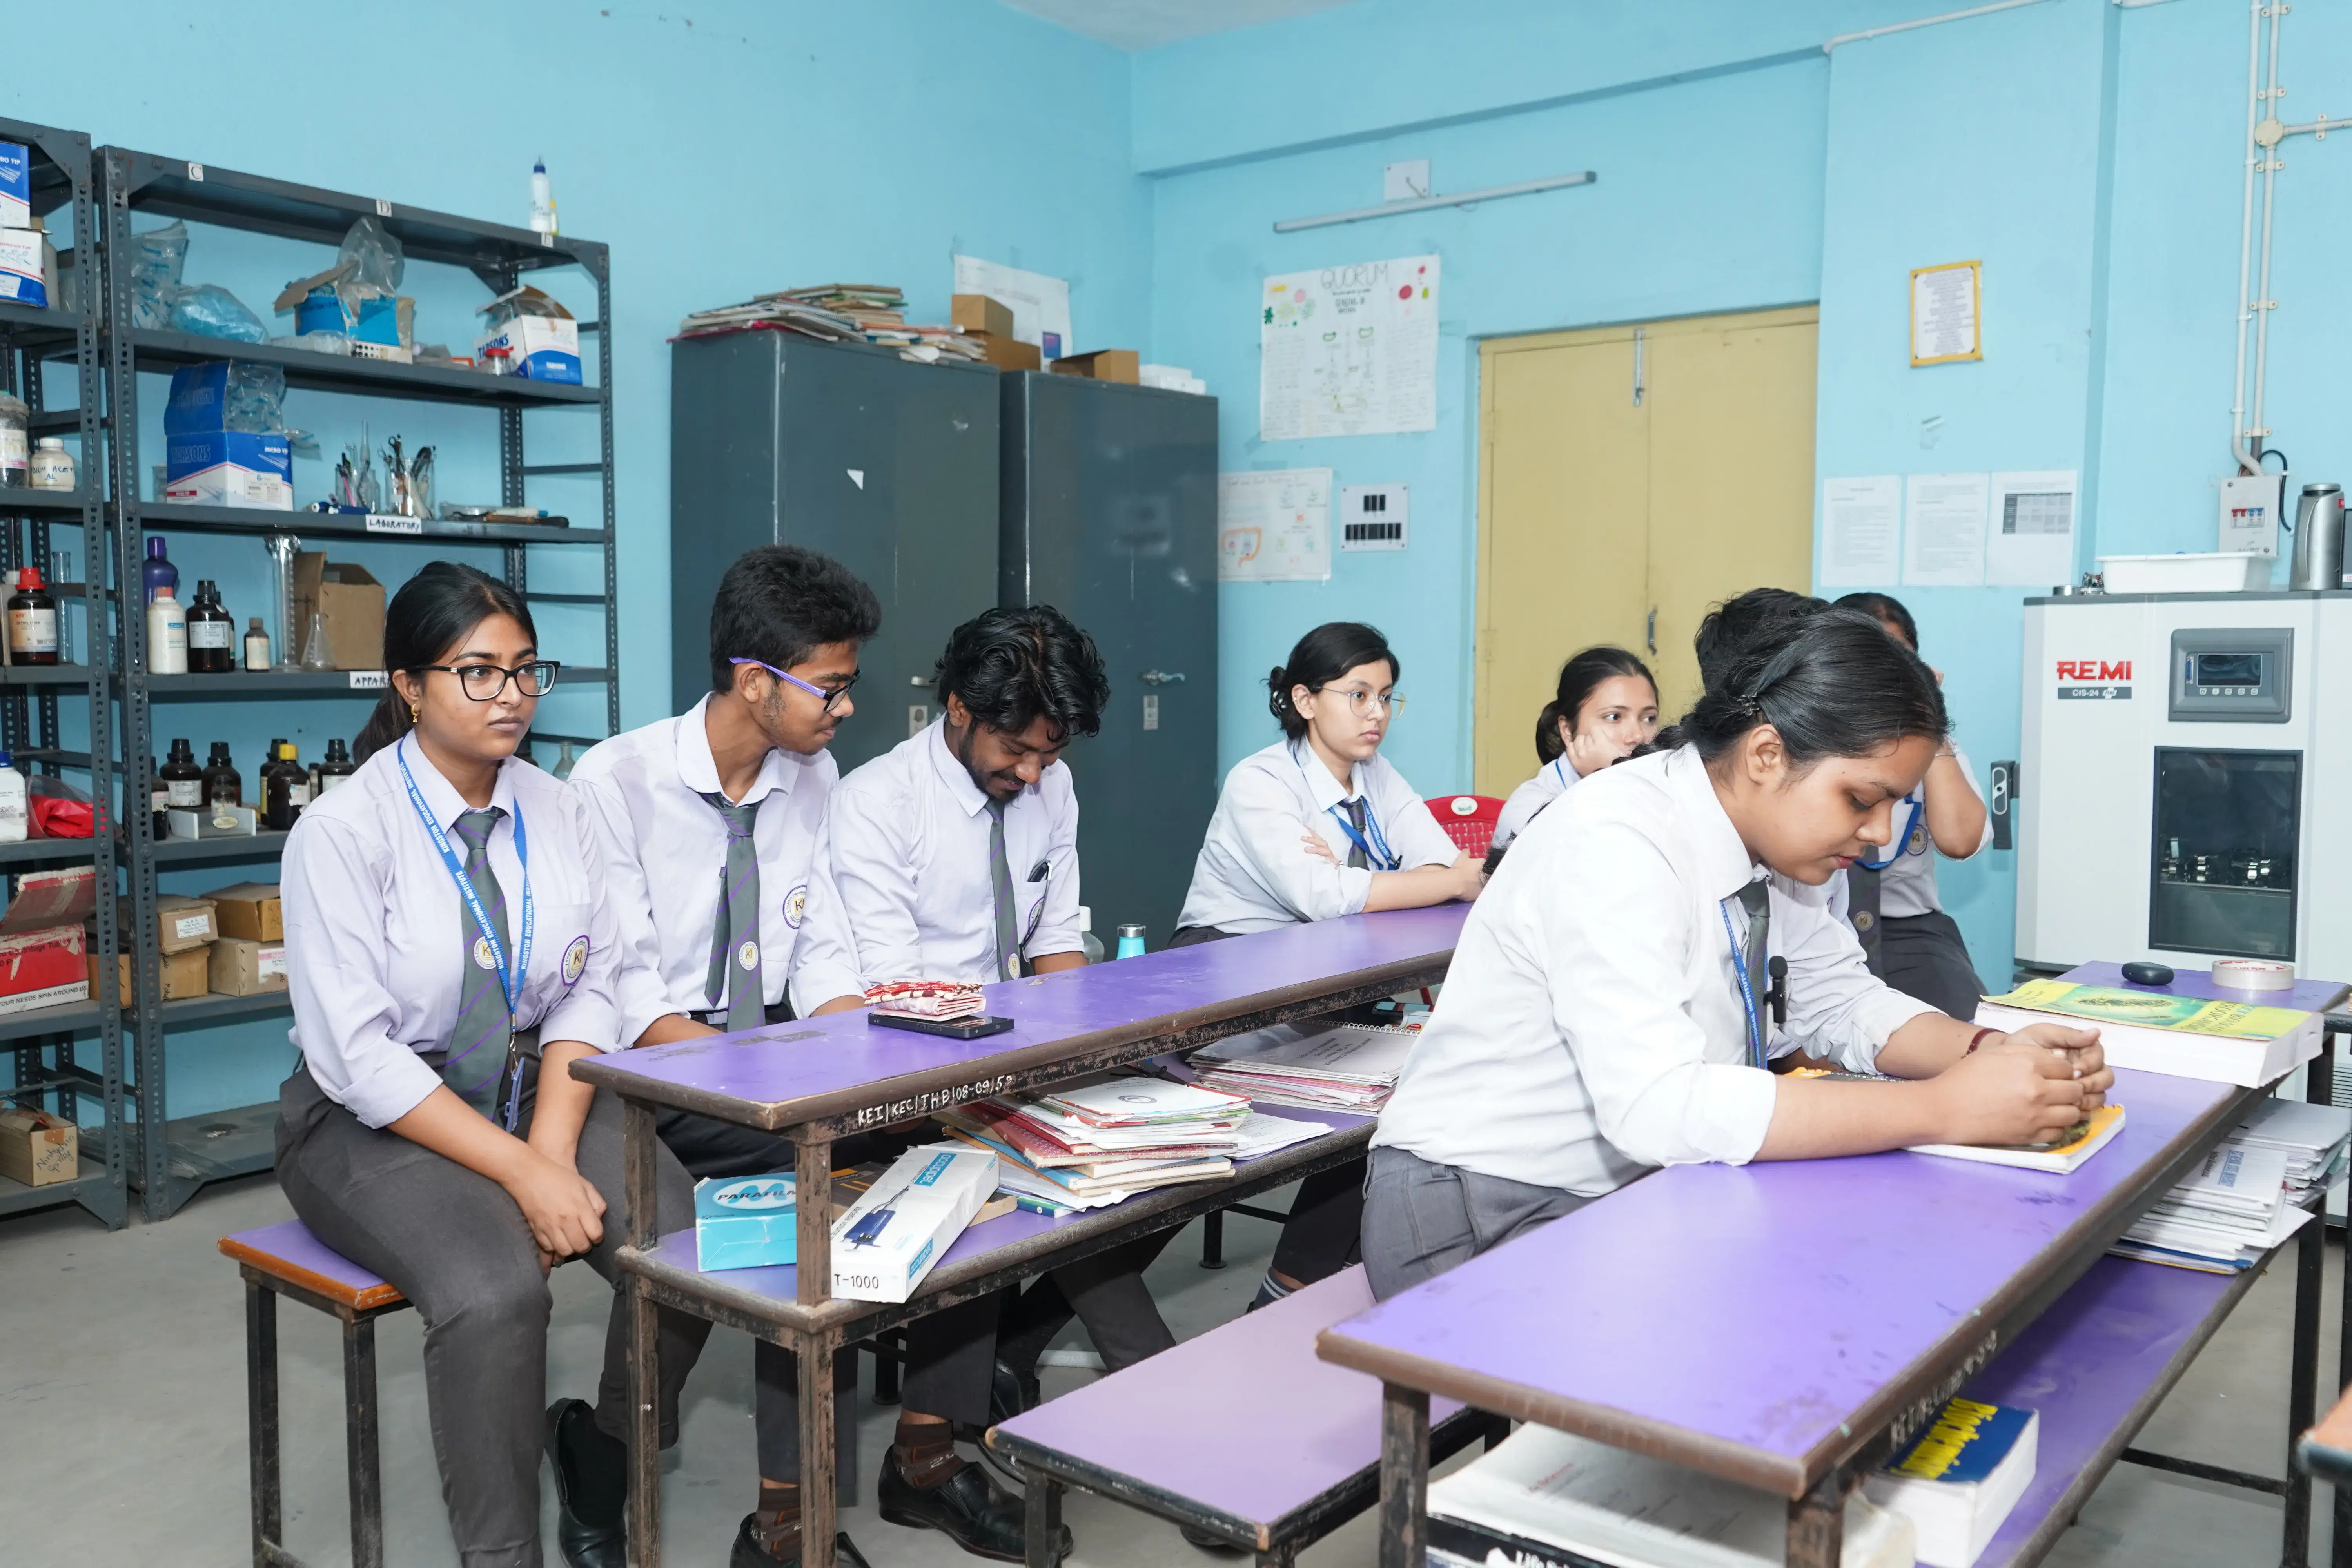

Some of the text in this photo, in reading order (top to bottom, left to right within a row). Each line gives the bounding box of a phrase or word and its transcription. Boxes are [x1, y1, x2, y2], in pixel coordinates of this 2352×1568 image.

[192, 166, 201, 179] C
[380, 201, 389, 214] D
[1320, 263, 1388, 289] QUORUM
[369, 518, 419, 532] LABORATORY
[2057, 661, 2132, 680] REMI
[2072, 688, 2099, 697] CIS-24
[411, 788, 434, 826] EDUCATIONAL
[430, 824, 451, 853] KINGSTON
[456, 870, 504, 970] KINGSTON EDUCATIONAL INSTITUTE
[521, 939, 531, 970] KINGSTON
[574, 950, 583, 964] KI
[746, 949, 753, 959] KI
[16, 995, 37, 1003] NEEDS
[54, 986, 78, 996] AROUND
[1740, 972, 1754, 1012] INSTITUTE
[834, 1274, 879, 1289] T-1000
